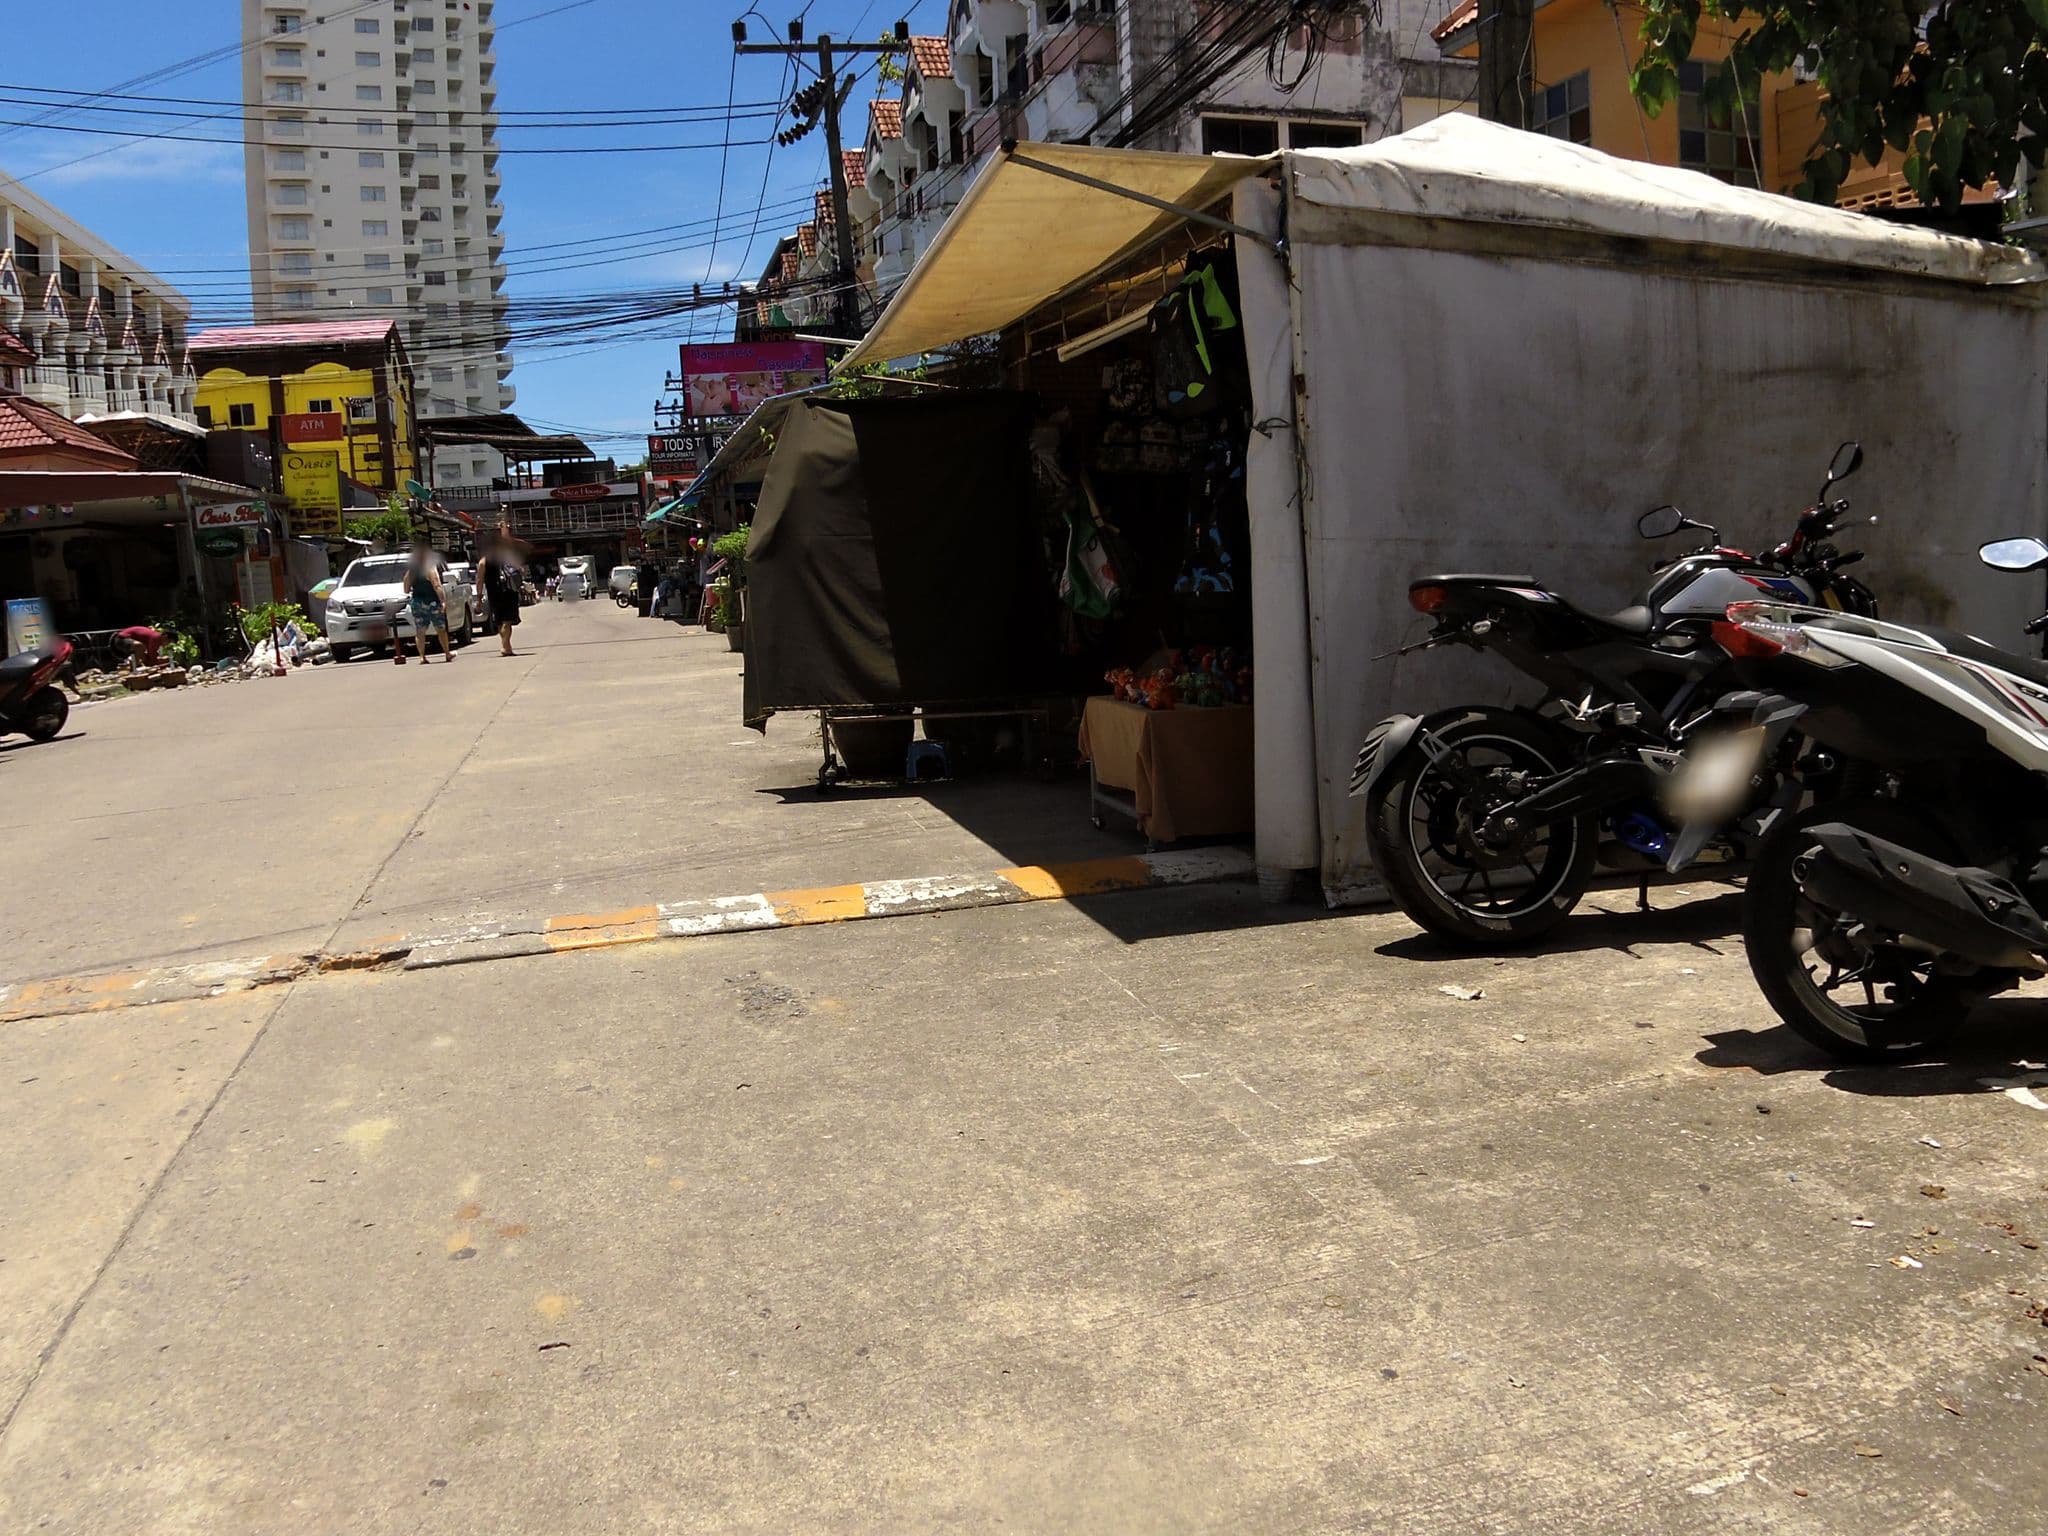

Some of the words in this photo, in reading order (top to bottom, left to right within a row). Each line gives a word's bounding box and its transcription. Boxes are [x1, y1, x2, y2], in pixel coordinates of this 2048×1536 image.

[300, 420, 325, 430] ATM
[663, 438, 693, 452] TOD'S
[287, 456, 332, 470] Oasis
